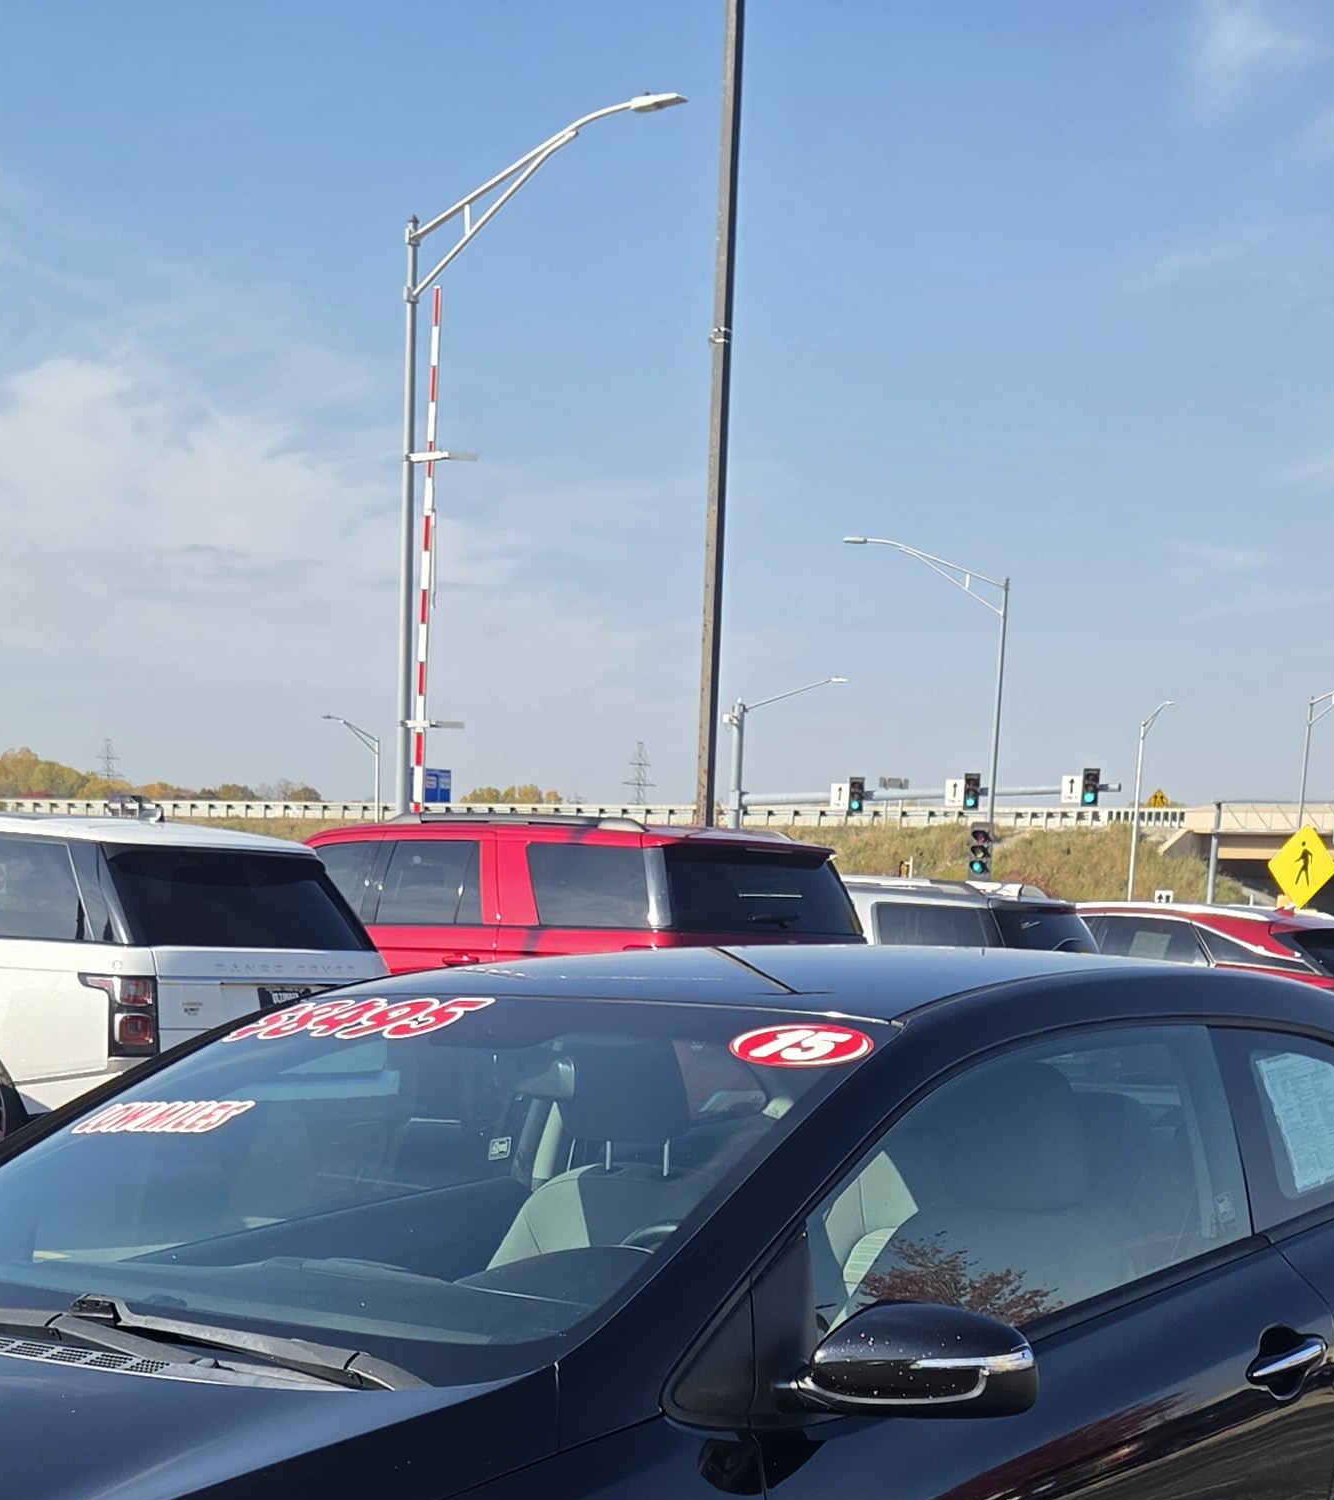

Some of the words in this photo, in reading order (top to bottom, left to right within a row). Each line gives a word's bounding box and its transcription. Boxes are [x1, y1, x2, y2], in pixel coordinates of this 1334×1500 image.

[749, 1029, 853, 1061] 15
[72, 1103, 165, 1133] LOW
[133, 1101, 255, 1132] MILES
